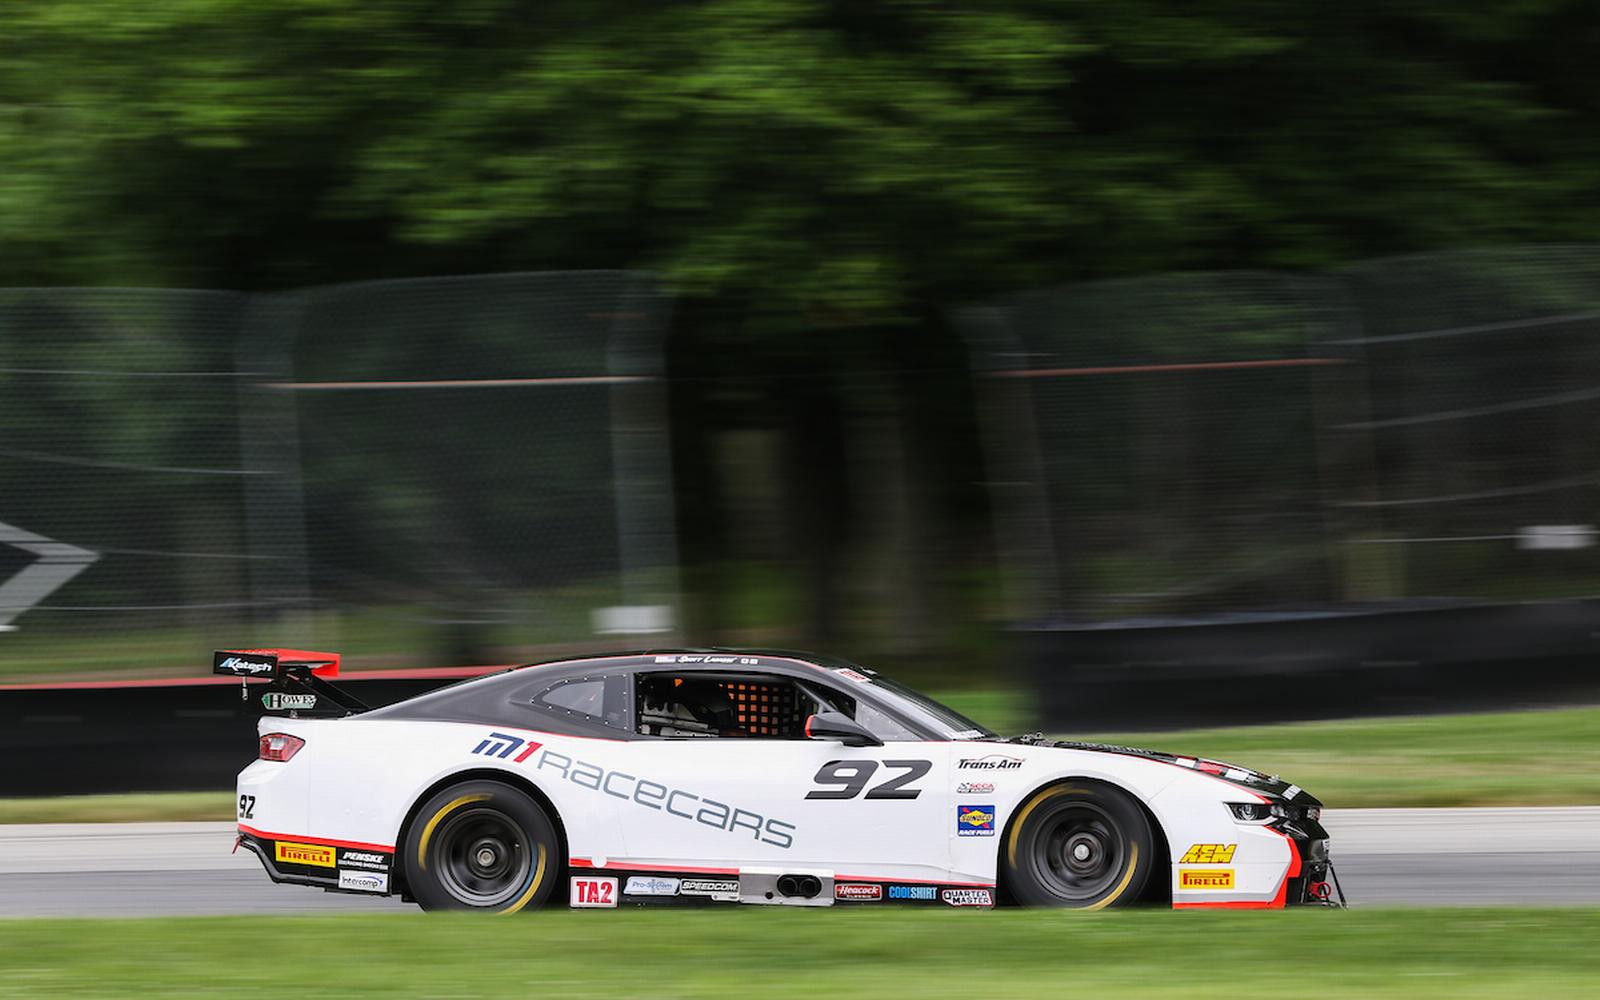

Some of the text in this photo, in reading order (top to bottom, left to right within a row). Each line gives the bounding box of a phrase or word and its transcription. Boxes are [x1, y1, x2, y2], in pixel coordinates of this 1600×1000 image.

[220, 657, 272, 673] Katech
[472, 732, 542, 762] M1
[958, 759, 1022, 769] Trans Am
[804, 760, 933, 800] 92
[239, 795, 255, 819] 92
[280, 846, 330, 863] PIRELLI
[343, 852, 384, 863] PENSKE
[1179, 844, 1237, 863] AEM
[342, 876, 378, 888] Intercomp
[682, 881, 738, 891] SPEEDCOM
[1183, 873, 1230, 885] PIRELLI
[576, 881, 612, 903] TA2
[839, 886, 878, 895] Heacock
[944, 890, 988, 899] QUARTER
